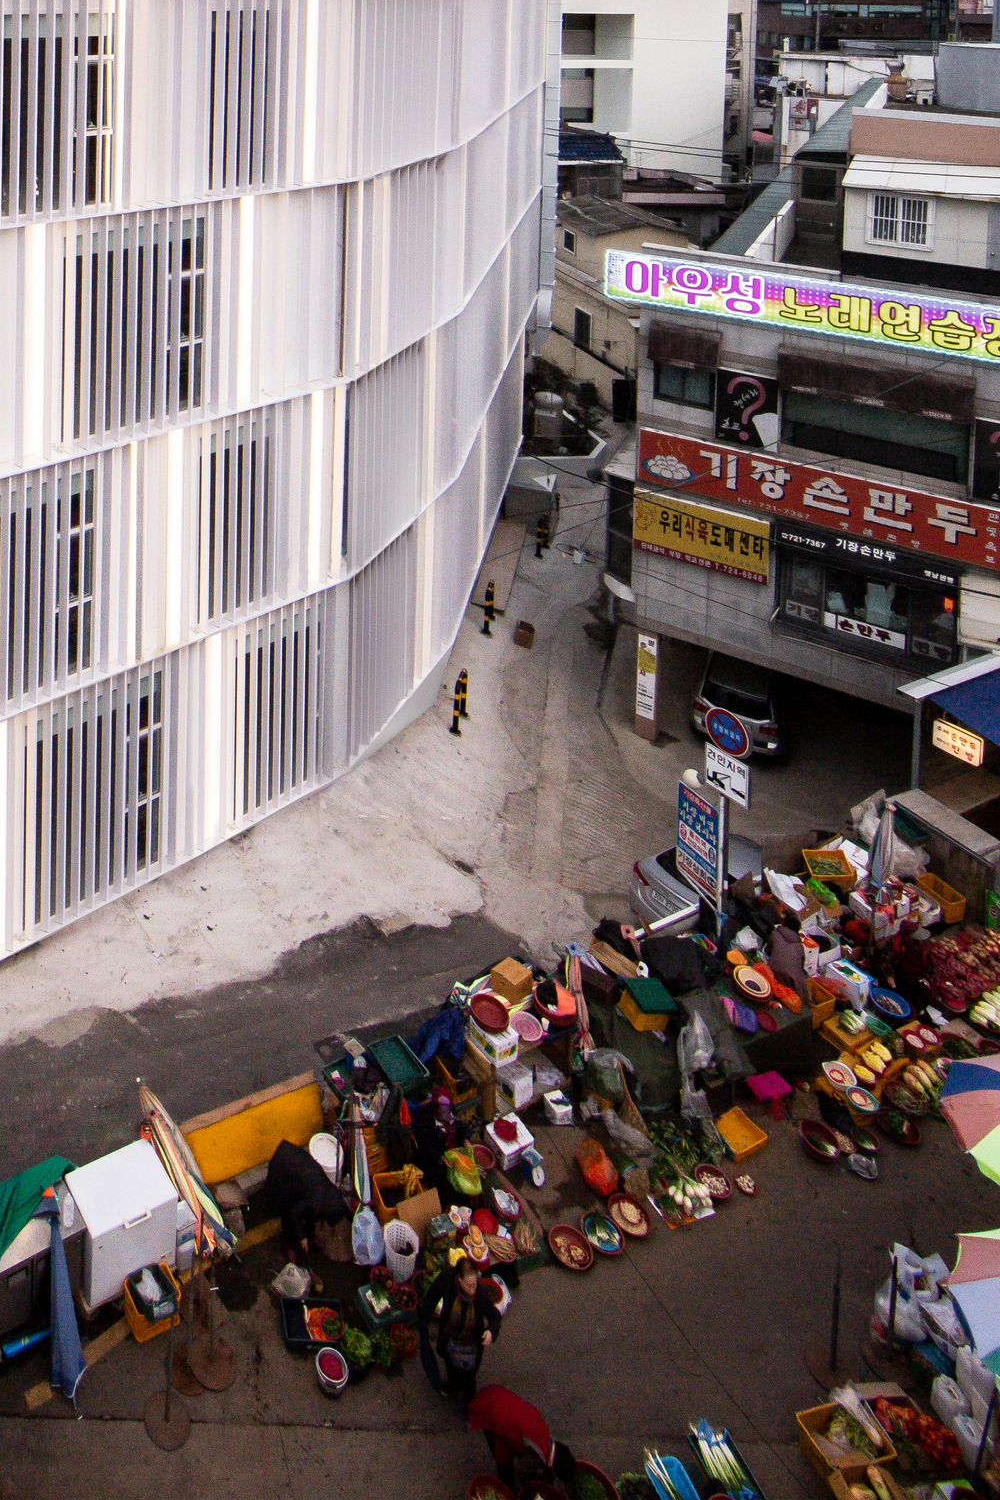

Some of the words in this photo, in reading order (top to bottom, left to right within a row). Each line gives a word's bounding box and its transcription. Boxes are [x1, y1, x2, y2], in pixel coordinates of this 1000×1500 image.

[625, 260, 761, 315] 아우성
[760, 502, 810, 520] 721-7367
[835, 538, 897, 562] 기장손만두
[838, 618, 892, 643] 손만두
[707, 747, 746, 779] 견인지역
